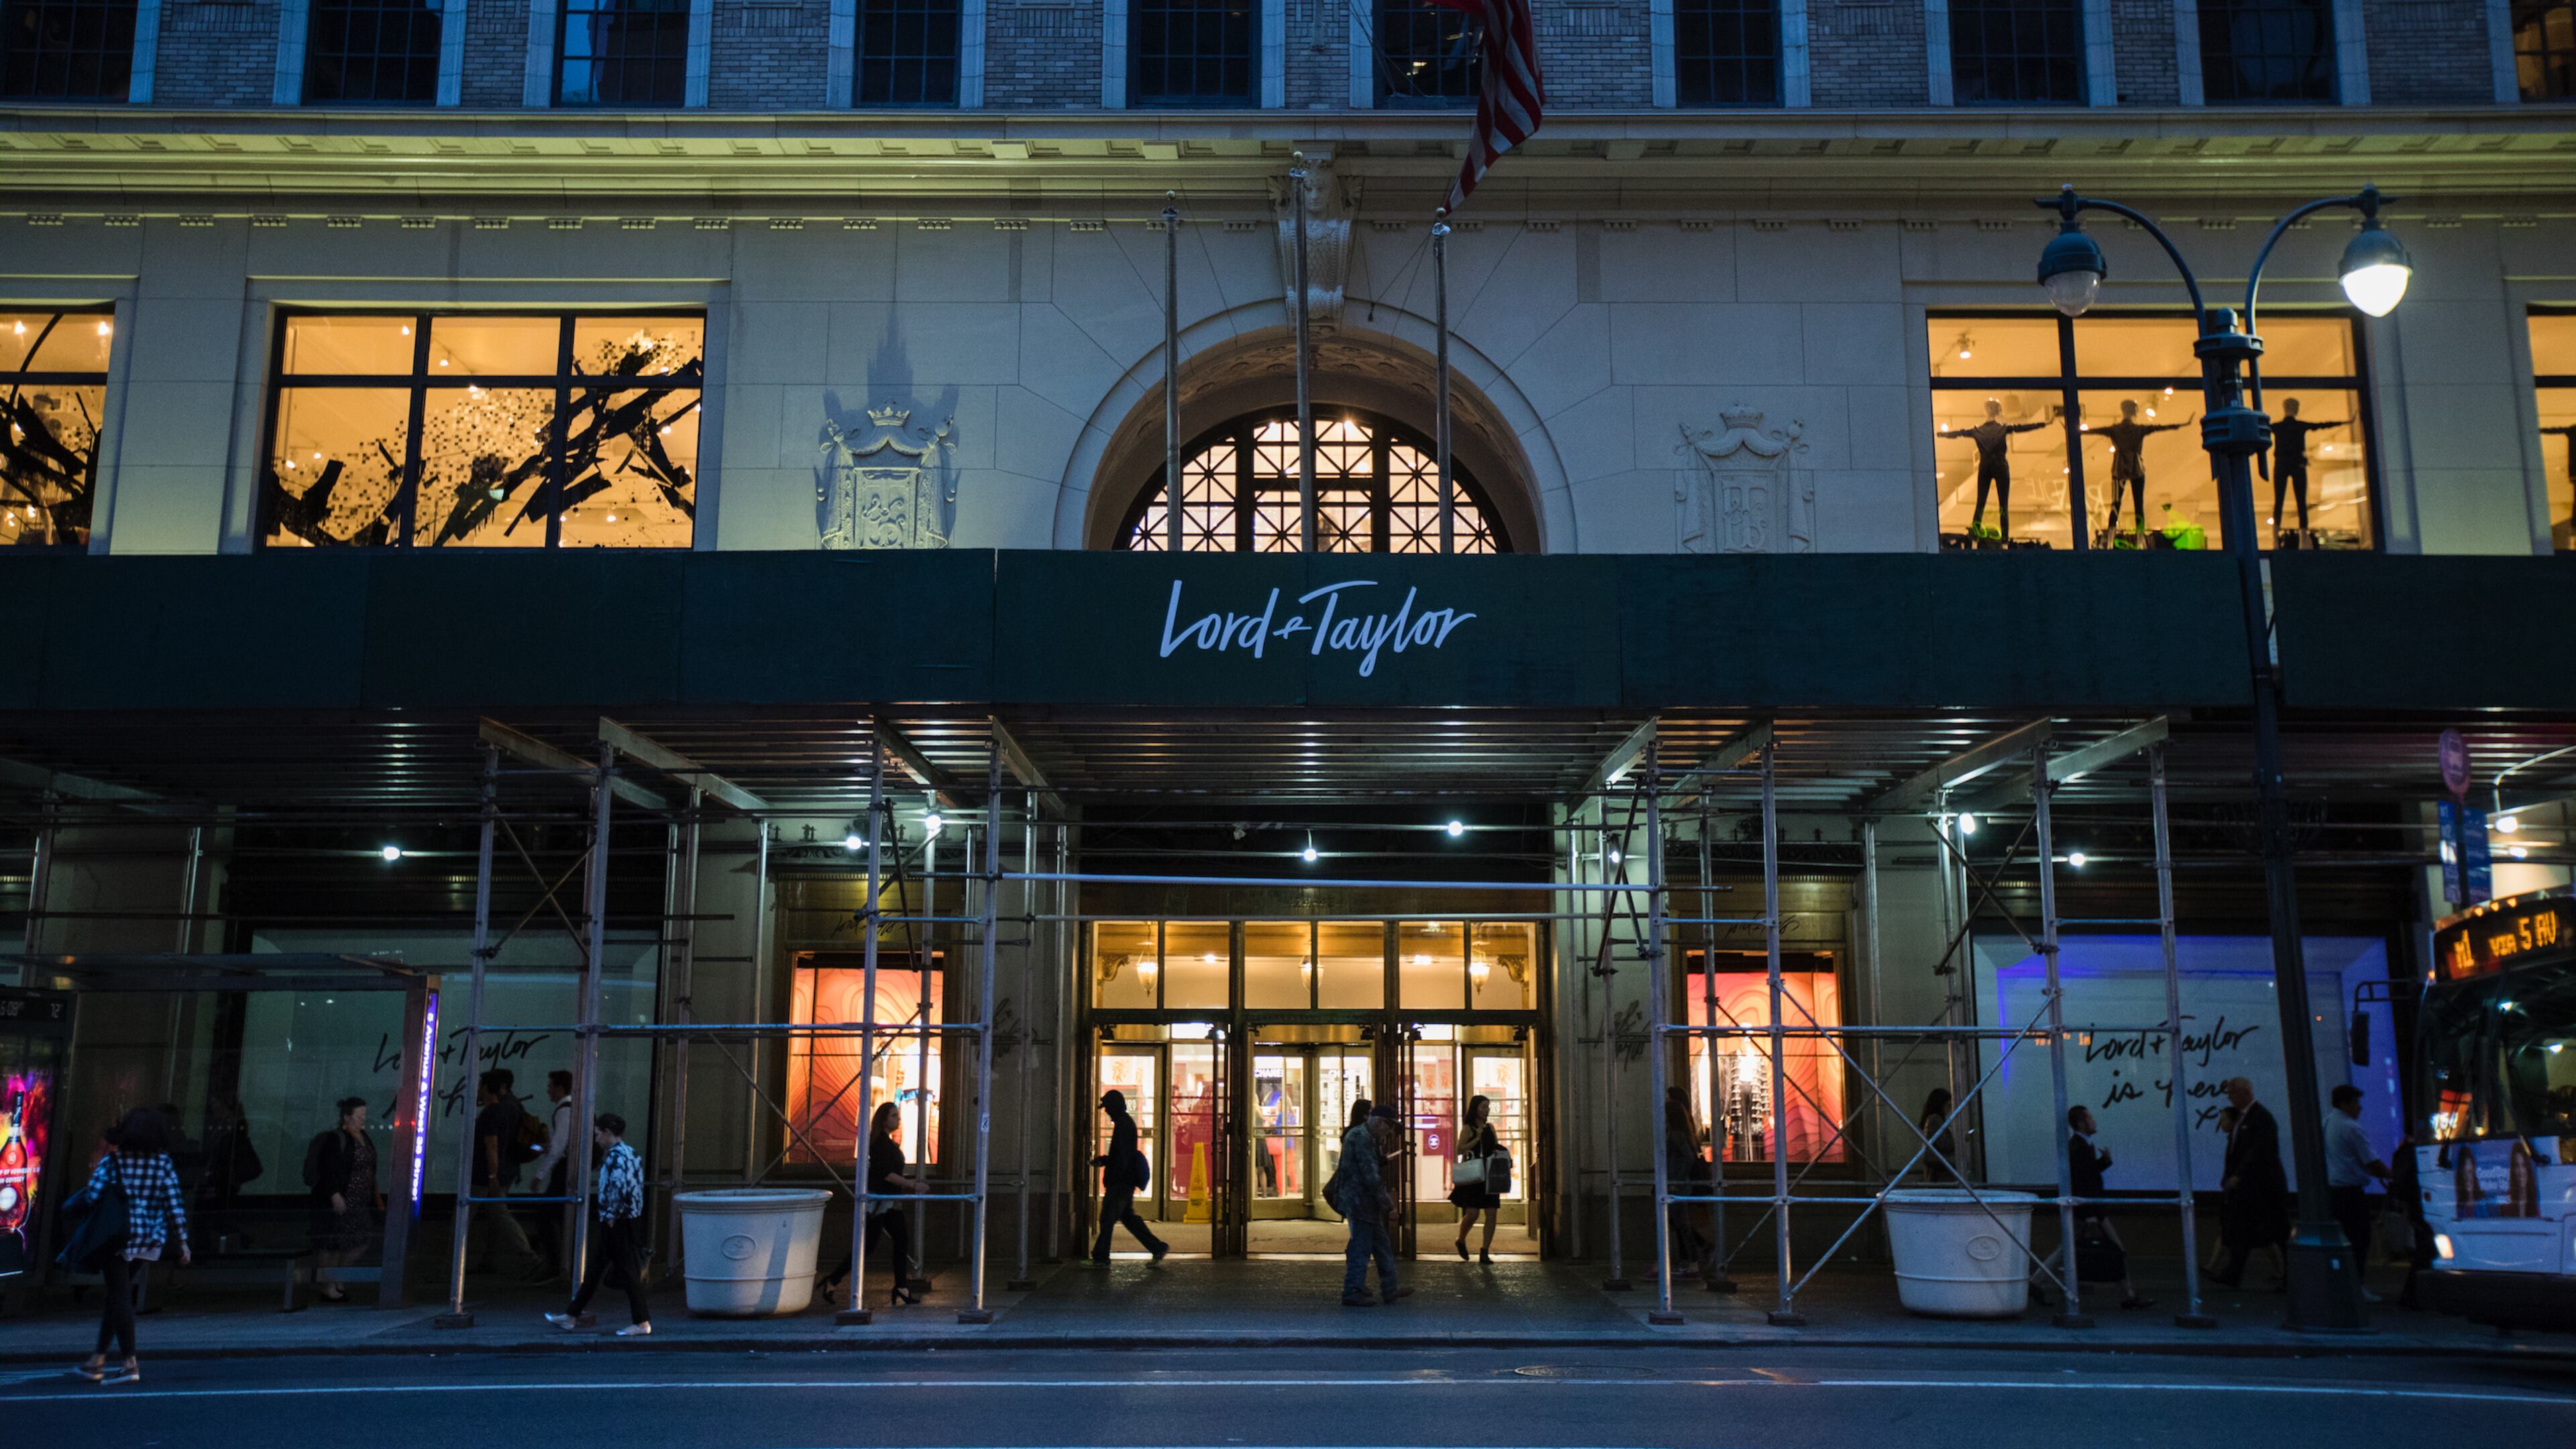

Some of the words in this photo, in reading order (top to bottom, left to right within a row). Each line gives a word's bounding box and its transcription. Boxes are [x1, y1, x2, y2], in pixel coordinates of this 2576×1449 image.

[1159, 579, 1280, 659] Lord
[1298, 579, 1477, 678] Taylor
[2518, 916, 2532, 951] 5
[422, 1024, 433, 1079] Avenue
[417, 1095, 427, 1133] West
[411, 1158, 421, 1201] Street
